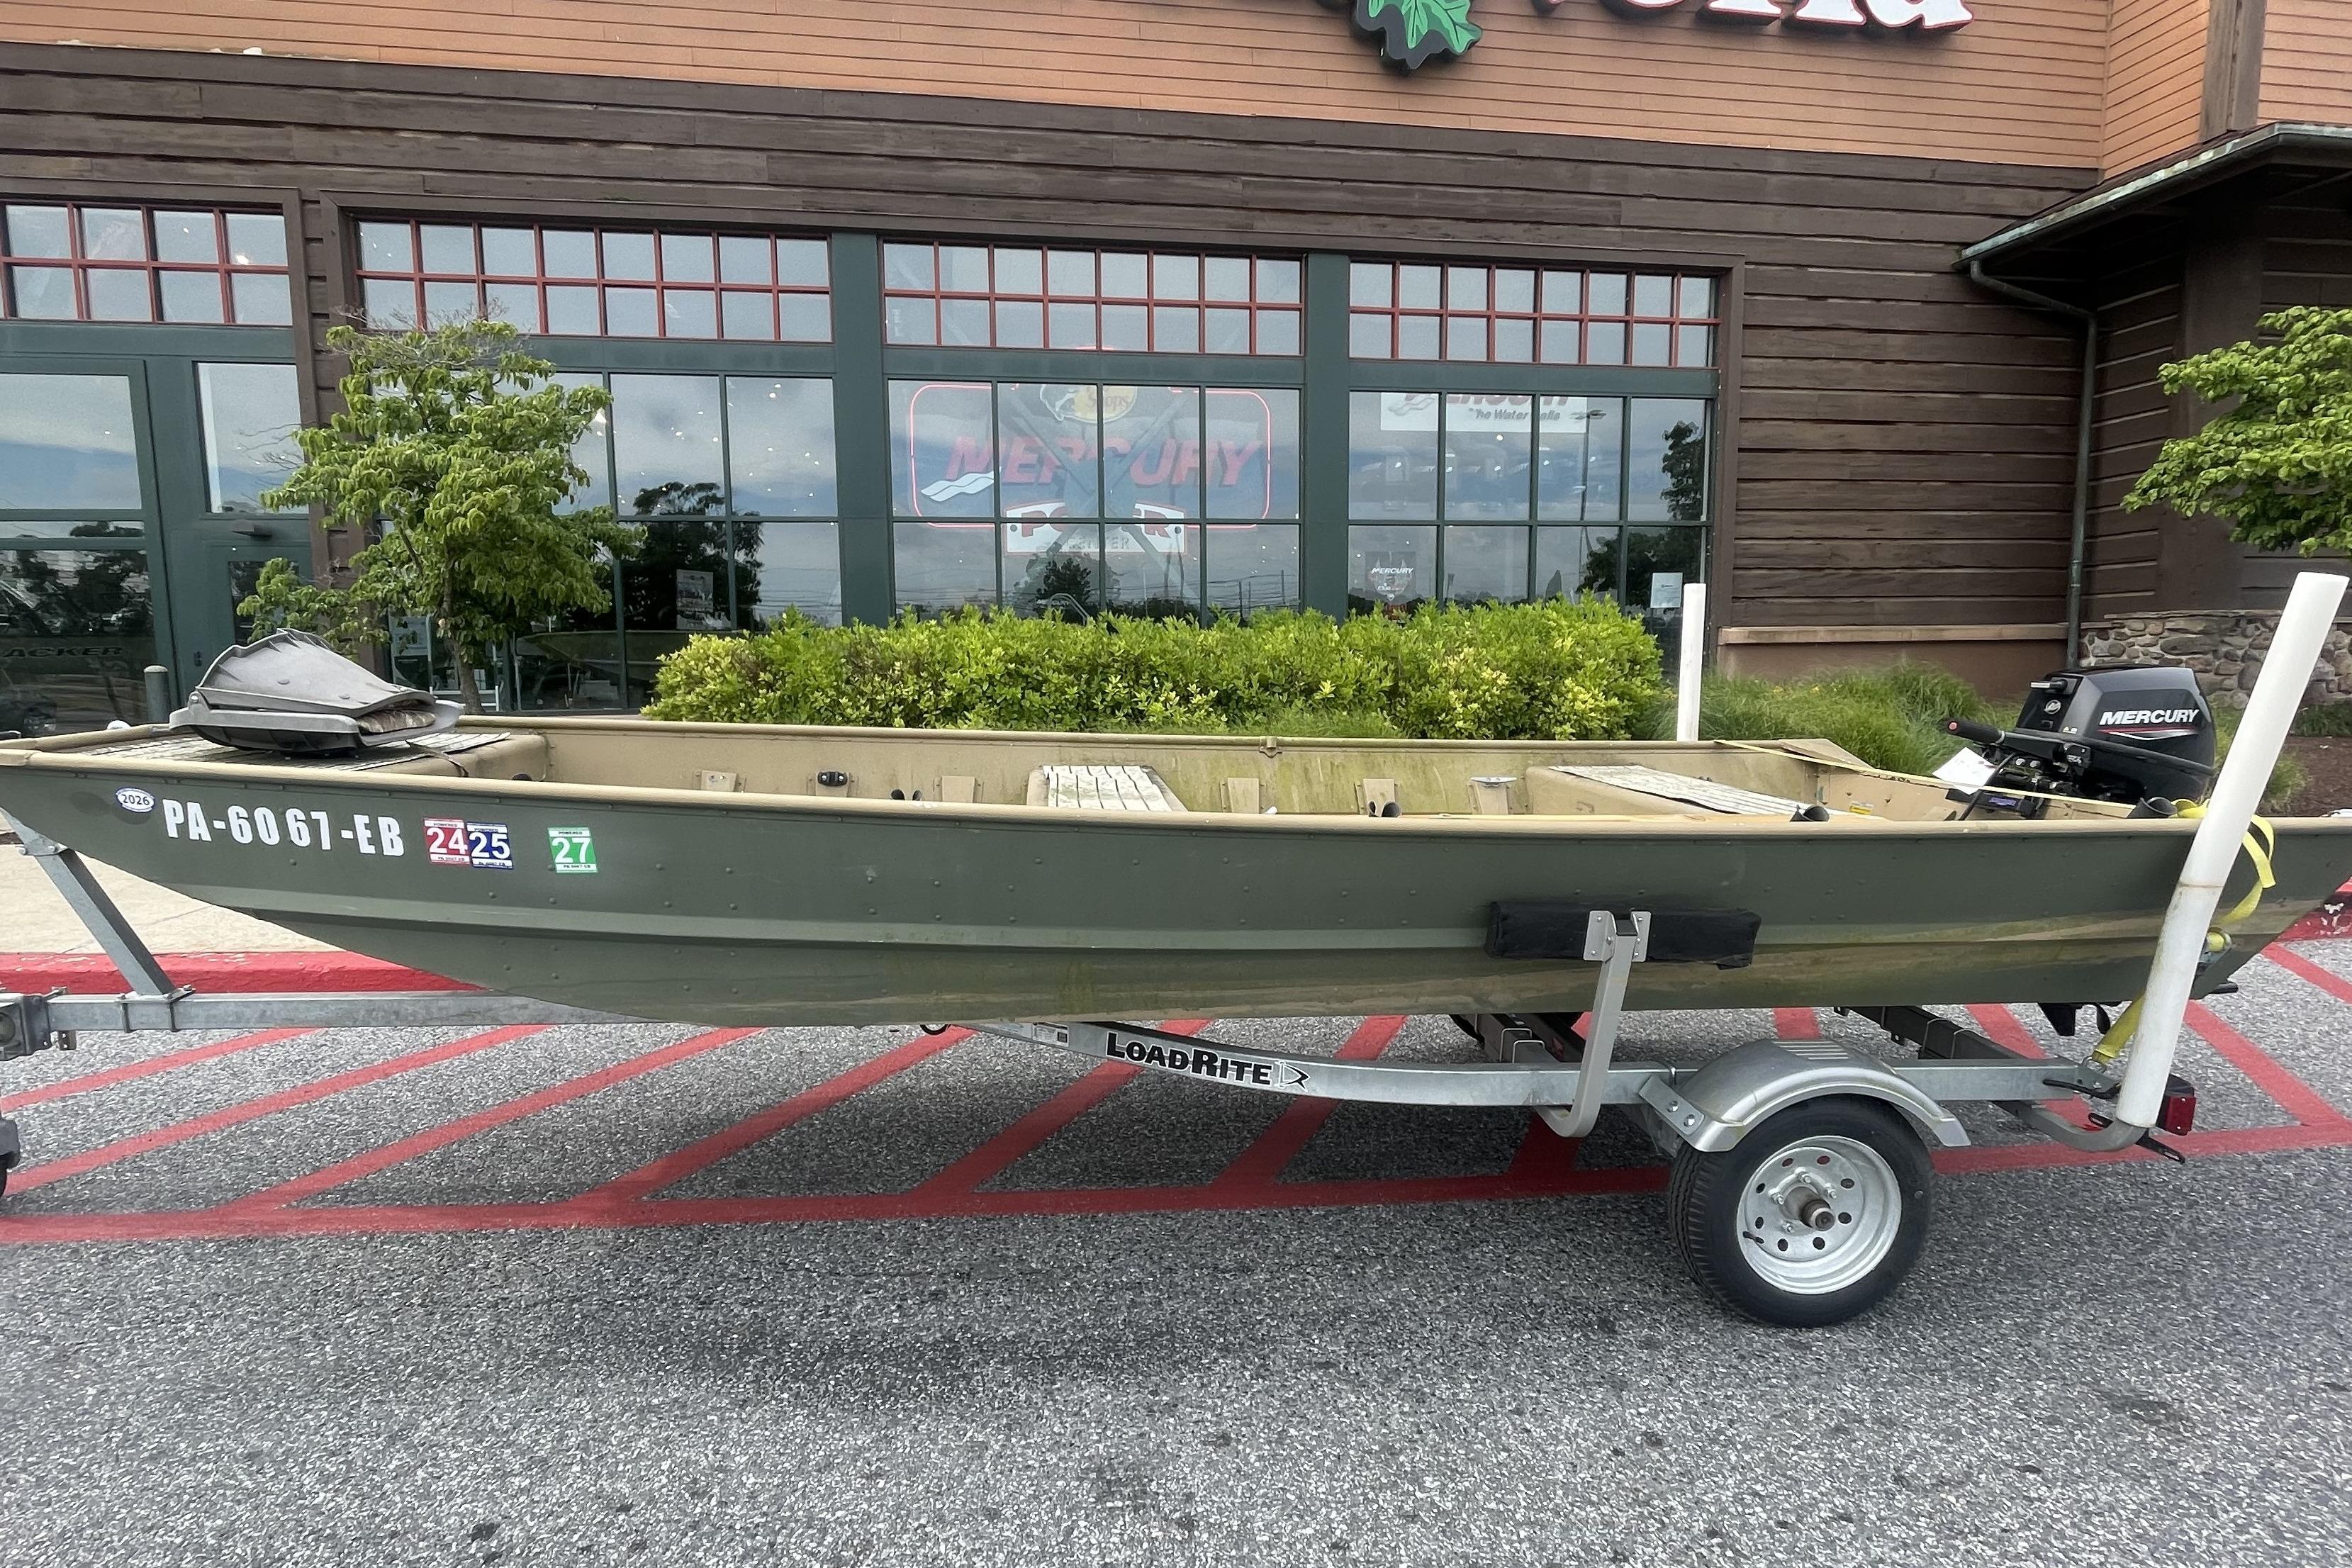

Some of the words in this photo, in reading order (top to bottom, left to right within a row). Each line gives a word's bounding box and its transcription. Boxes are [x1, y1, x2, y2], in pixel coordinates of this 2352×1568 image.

[1085, 396, 1130, 413] Sops
[1494, 409, 1530, 420] Water
[1540, 410, 1561, 420] alls
[2099, 709, 2200, 726] MERCURY
[122, 794, 150, 806] 2026
[426, 827, 468, 855] 24
[469, 831, 510, 859] 25
[552, 837, 590, 863] 27
[1106, 1031, 1274, 1086] LOADRITE
